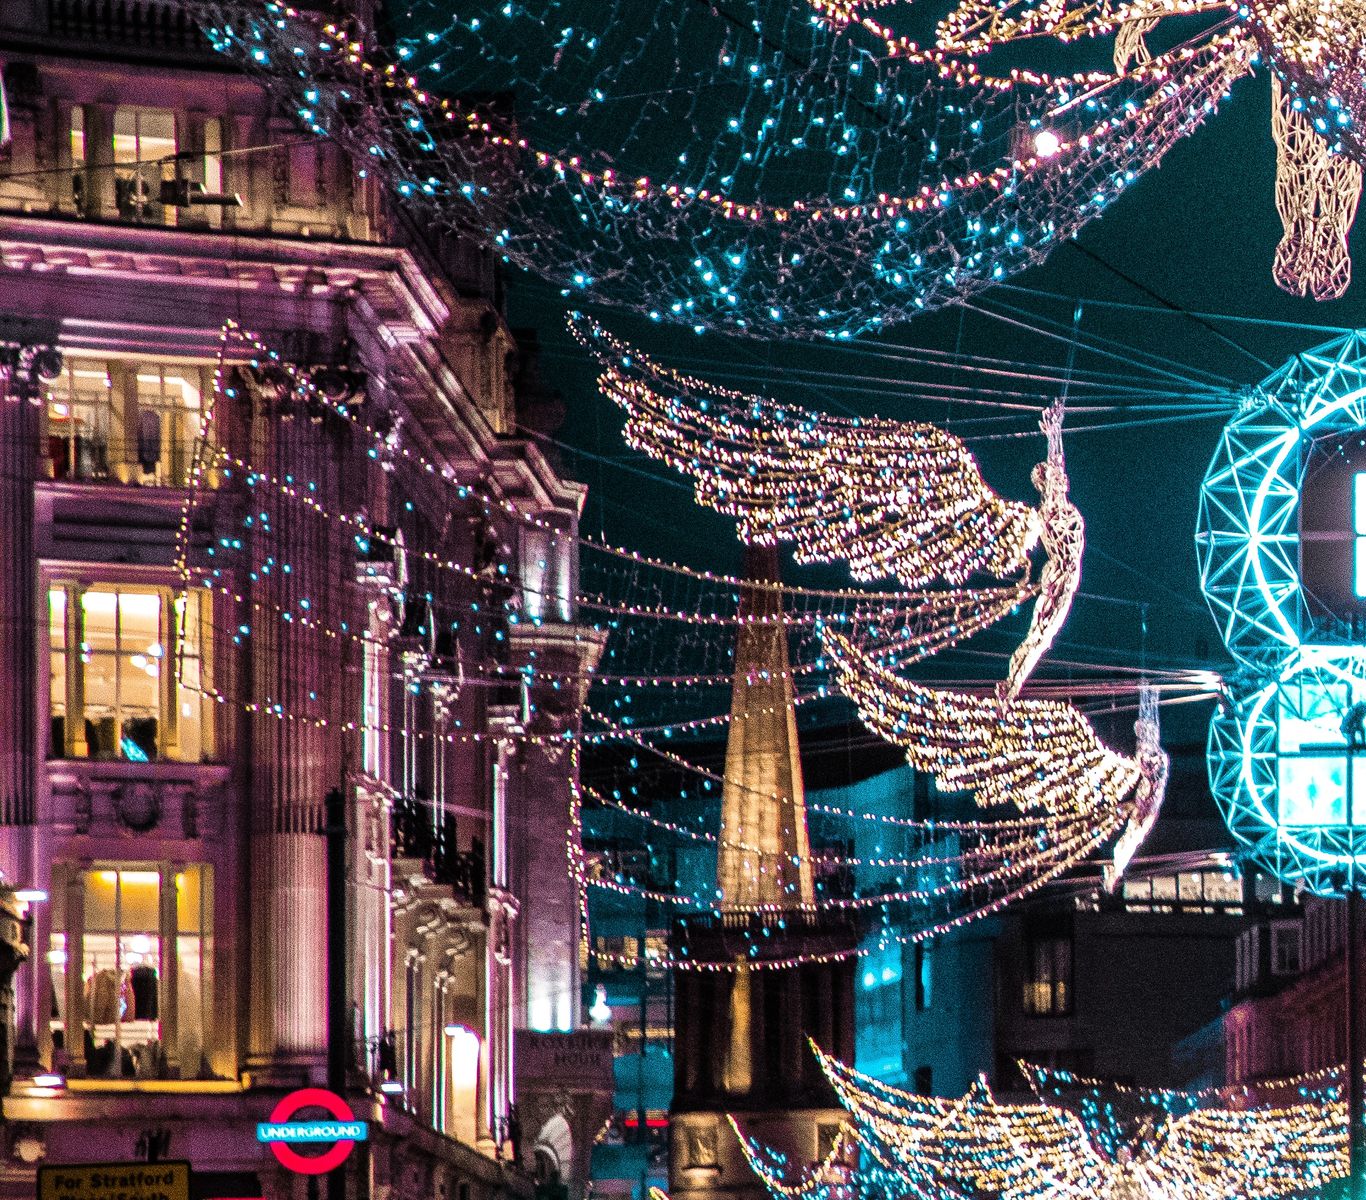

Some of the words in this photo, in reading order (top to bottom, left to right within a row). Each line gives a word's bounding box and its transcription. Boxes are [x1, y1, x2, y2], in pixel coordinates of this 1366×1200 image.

[261, 1125, 361, 1139] UNDERGROUND
[53, 1175, 81, 1189] For
[90, 1171, 174, 1188] Stratford
